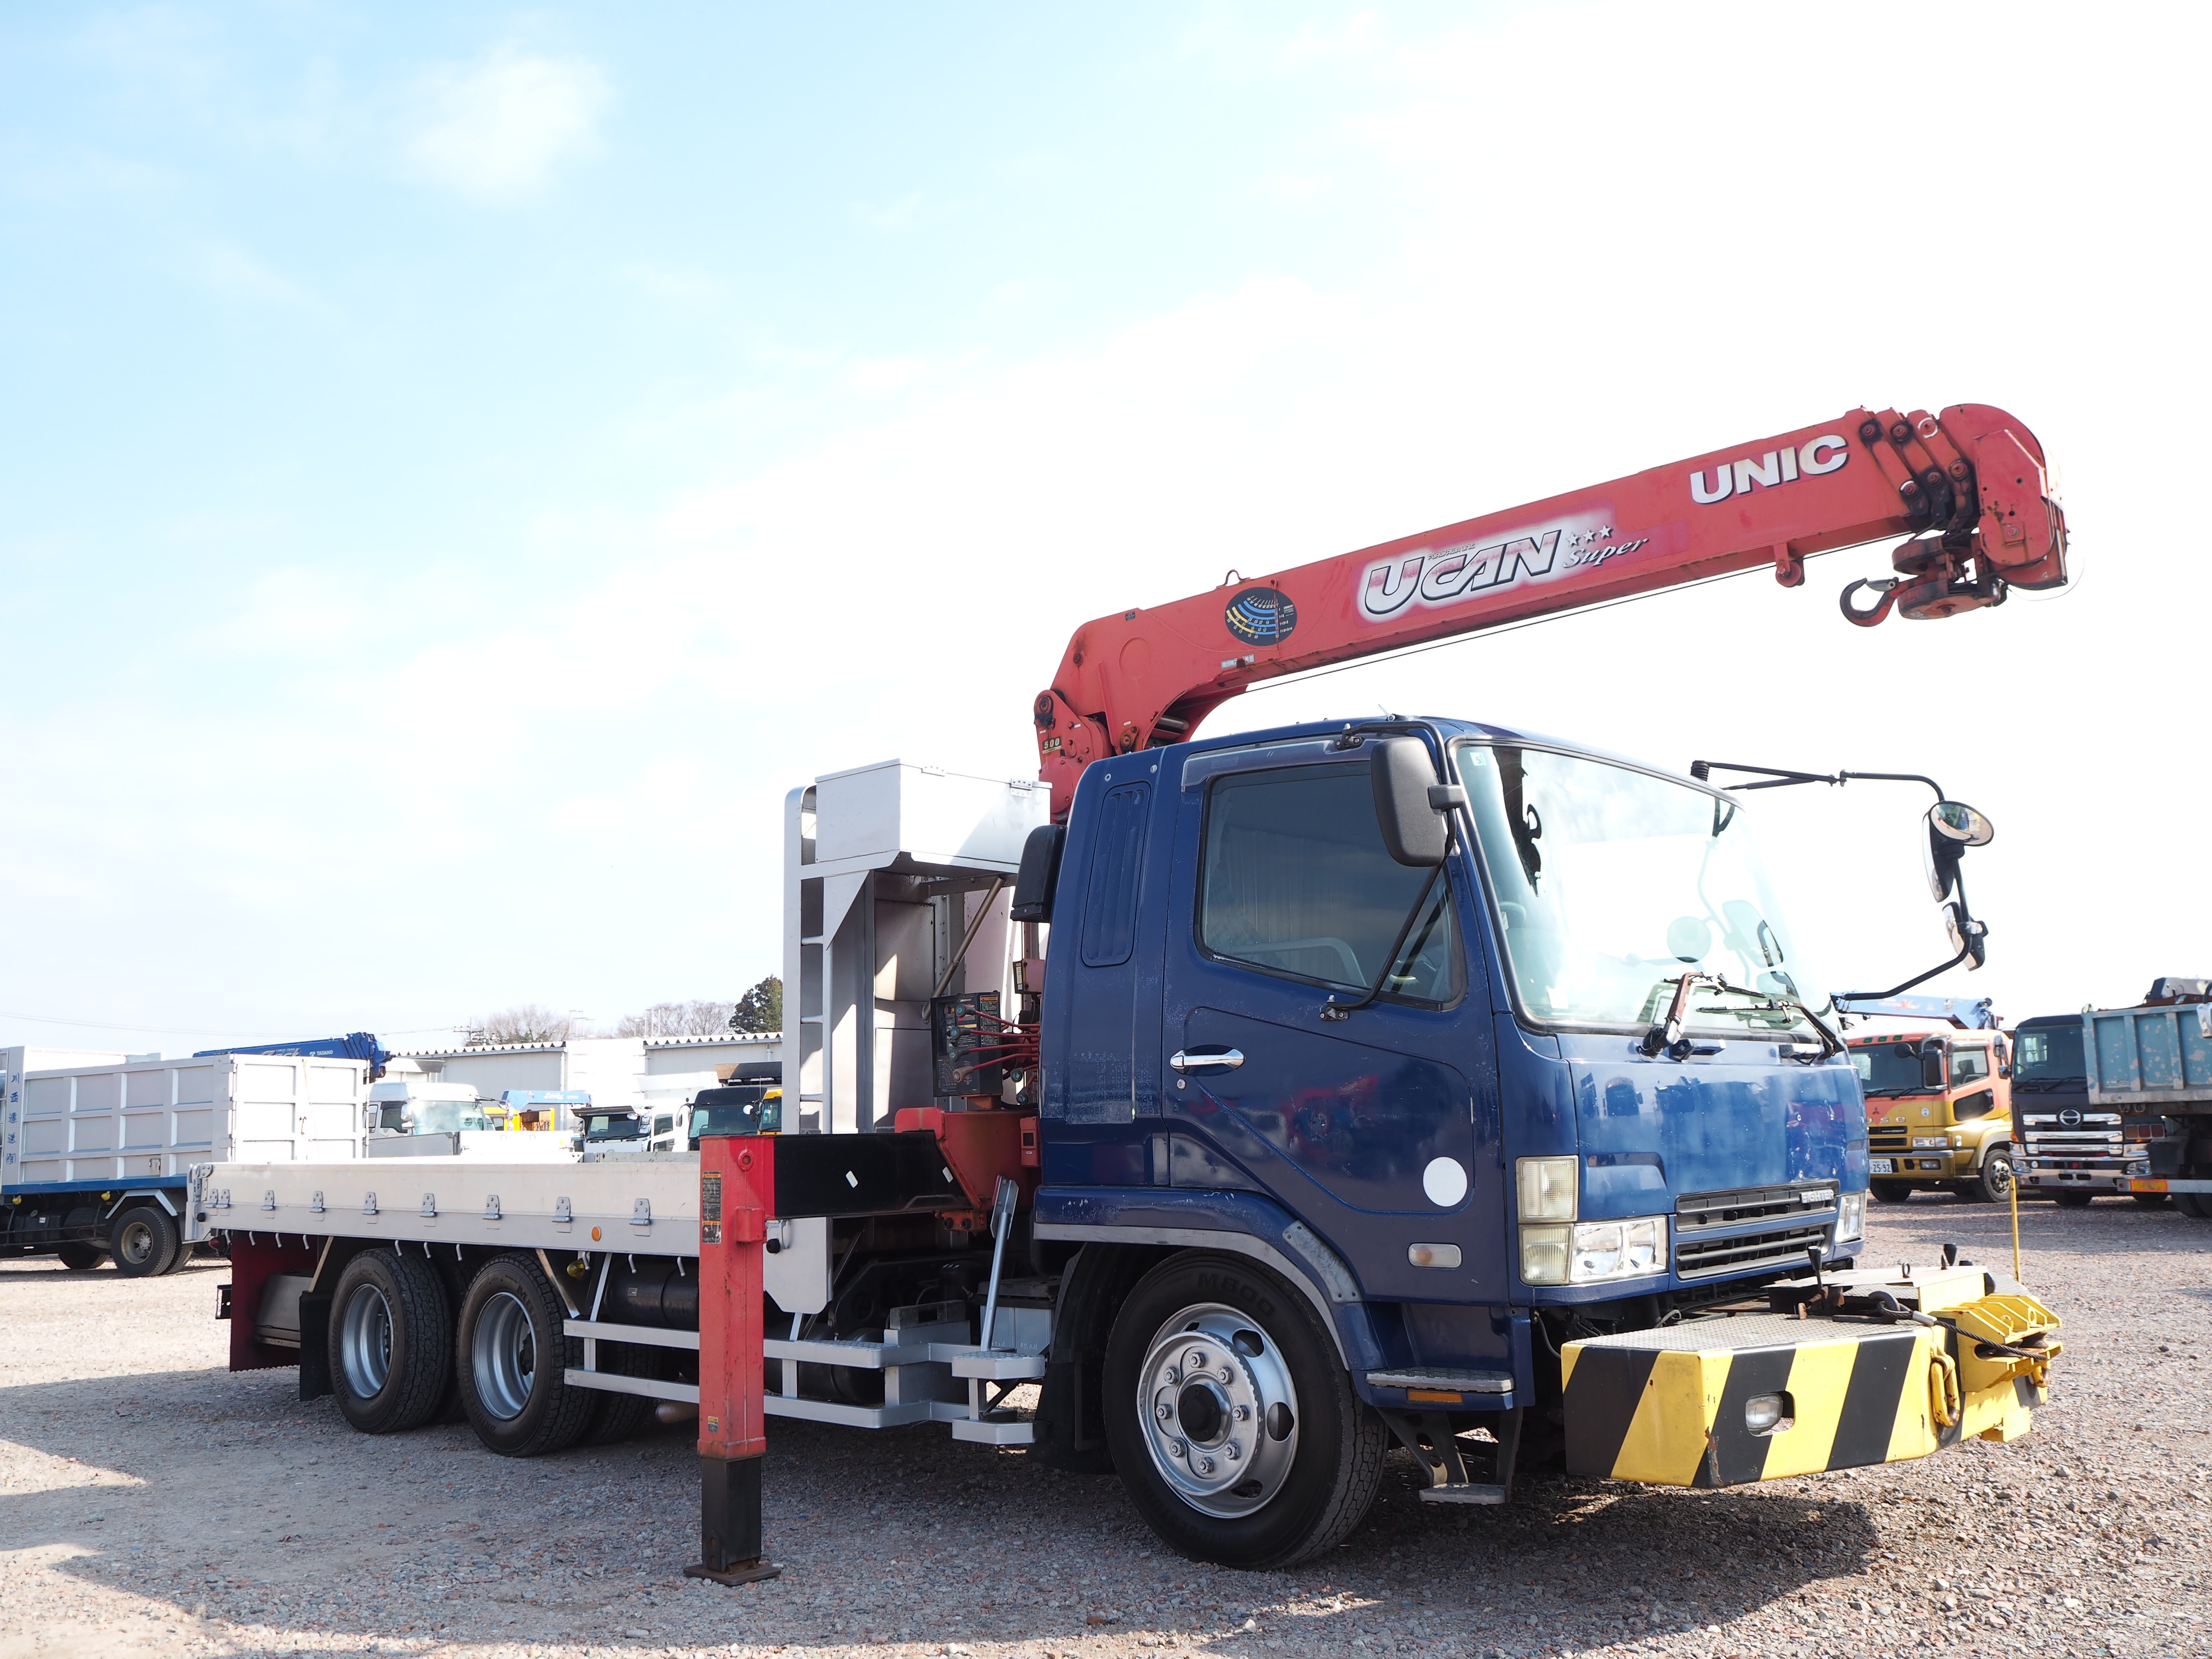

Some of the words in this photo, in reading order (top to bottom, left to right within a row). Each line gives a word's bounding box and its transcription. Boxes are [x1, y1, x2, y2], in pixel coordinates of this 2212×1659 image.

[1690, 434, 1850, 504] UNIC
[1428, 547, 1460, 560] FURUKAWA
[1461, 543, 1476, 552] UNIC
[1562, 538, 1649, 569] Super
[1365, 529, 1562, 614] UCAN
[1044, 737, 1060, 749] 500
[1873, 1164, 1891, 1173] 25-92
[1802, 1190, 1835, 1203] FIGHTER
[1197, 1273, 1277, 1318] M800
